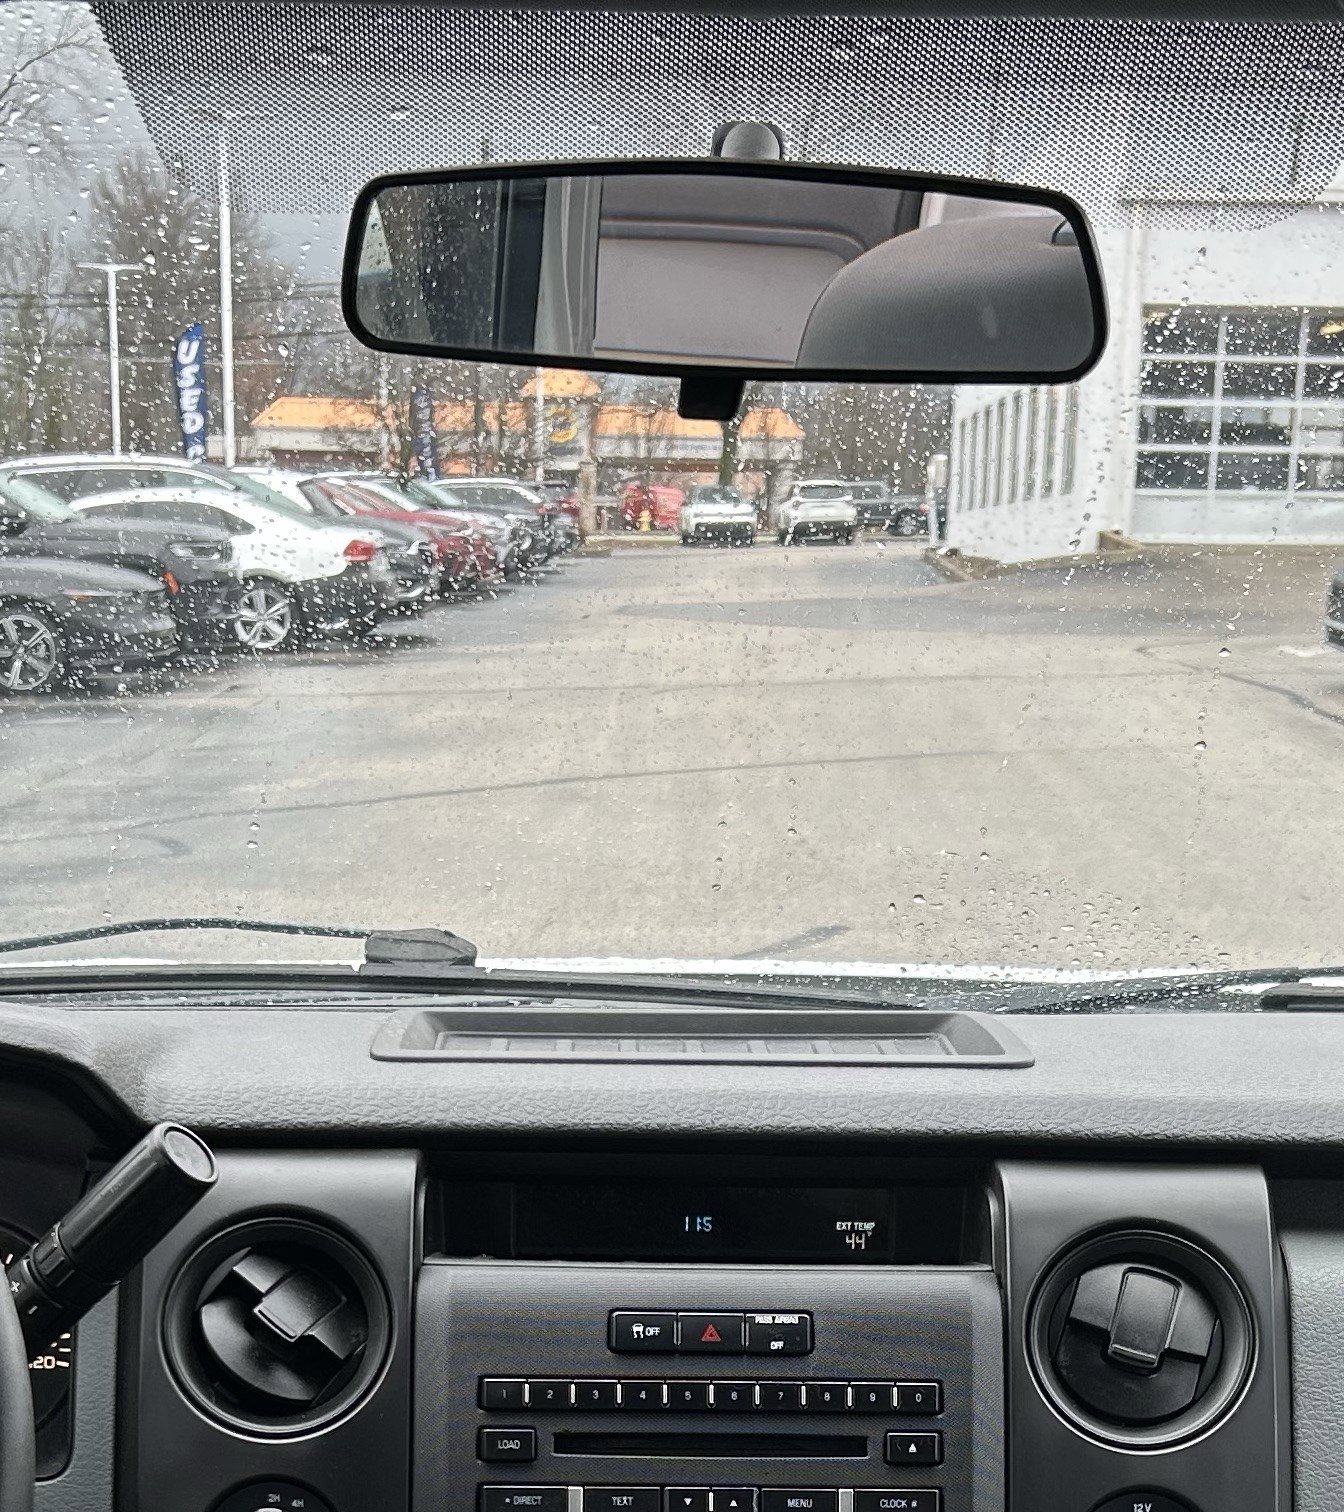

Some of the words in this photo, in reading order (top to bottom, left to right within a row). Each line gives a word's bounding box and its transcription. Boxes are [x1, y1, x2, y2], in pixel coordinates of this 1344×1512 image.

[177, 338, 204, 435] USED
[836, 1221, 852, 1231] EXT
[853, 1221, 876, 1231] TEMP
[645, 1326, 661, 1337] OFF
[770, 1340, 785, 1350] OFF
[29, 1355, 56, 1369] 20
[502, 1389, 507, 1399] 1
[546, 1389, 554, 1399] 2
[592, 1389, 599, 1400] 3
[639, 1390, 647, 1400] 4
[684, 1390, 692, 1401] 5
[731, 1391, 738, 1401] 6
[778, 1391, 784, 1400] 7
[823, 1391, 831, 1402] 8
[869, 1392, 876, 1402] 9
[497, 1439, 521, 1450] LOAD
[267, 1493, 281, 1503] 2H
[291, 1499, 305, 1508] 4H
[513, 1495, 543, 1506] DIRECT
[611, 1495, 634, 1506] TEXT
[787, 1498, 813, 1509] MENU
[879, 1498, 908, 1509] CLOCK
